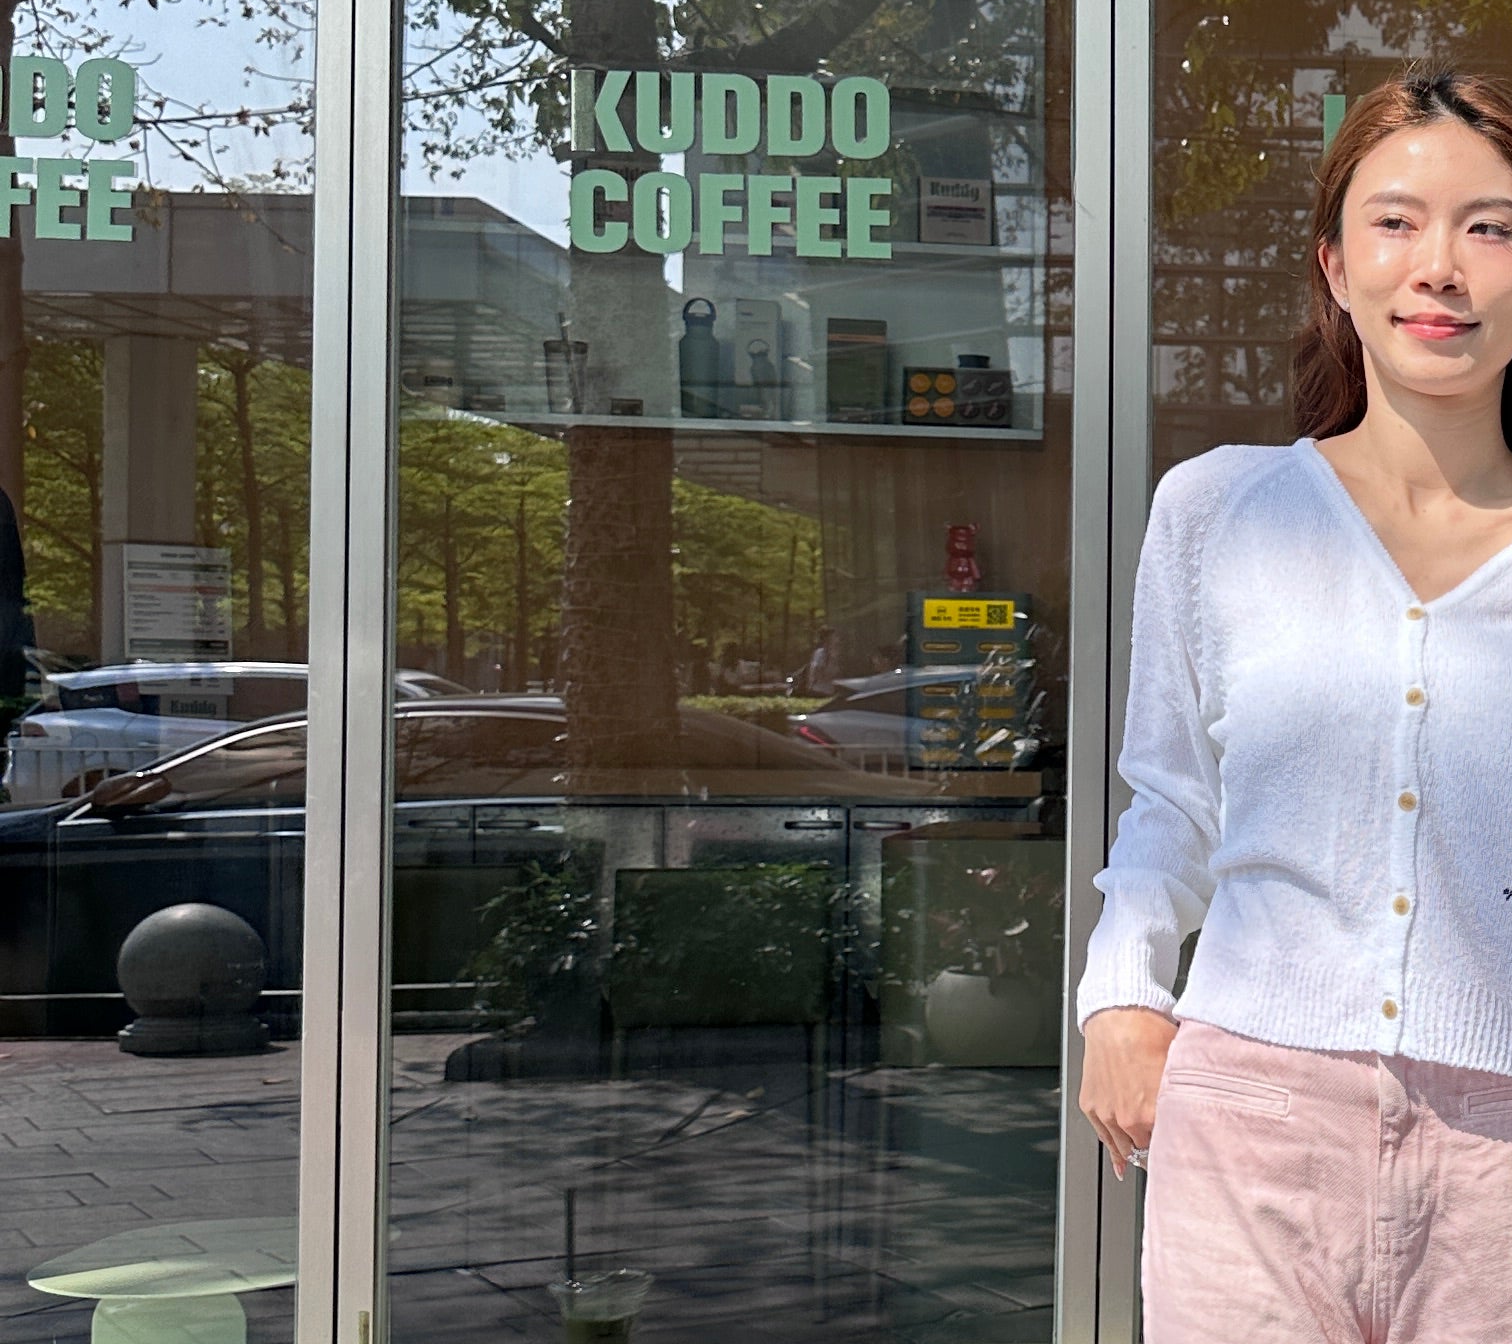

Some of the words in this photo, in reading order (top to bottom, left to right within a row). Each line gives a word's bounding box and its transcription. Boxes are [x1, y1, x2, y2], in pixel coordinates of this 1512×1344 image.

[0, 56, 134, 143] DO
[571, 68, 892, 159] KUDDO
[569, 169, 892, 259] COFFEE
